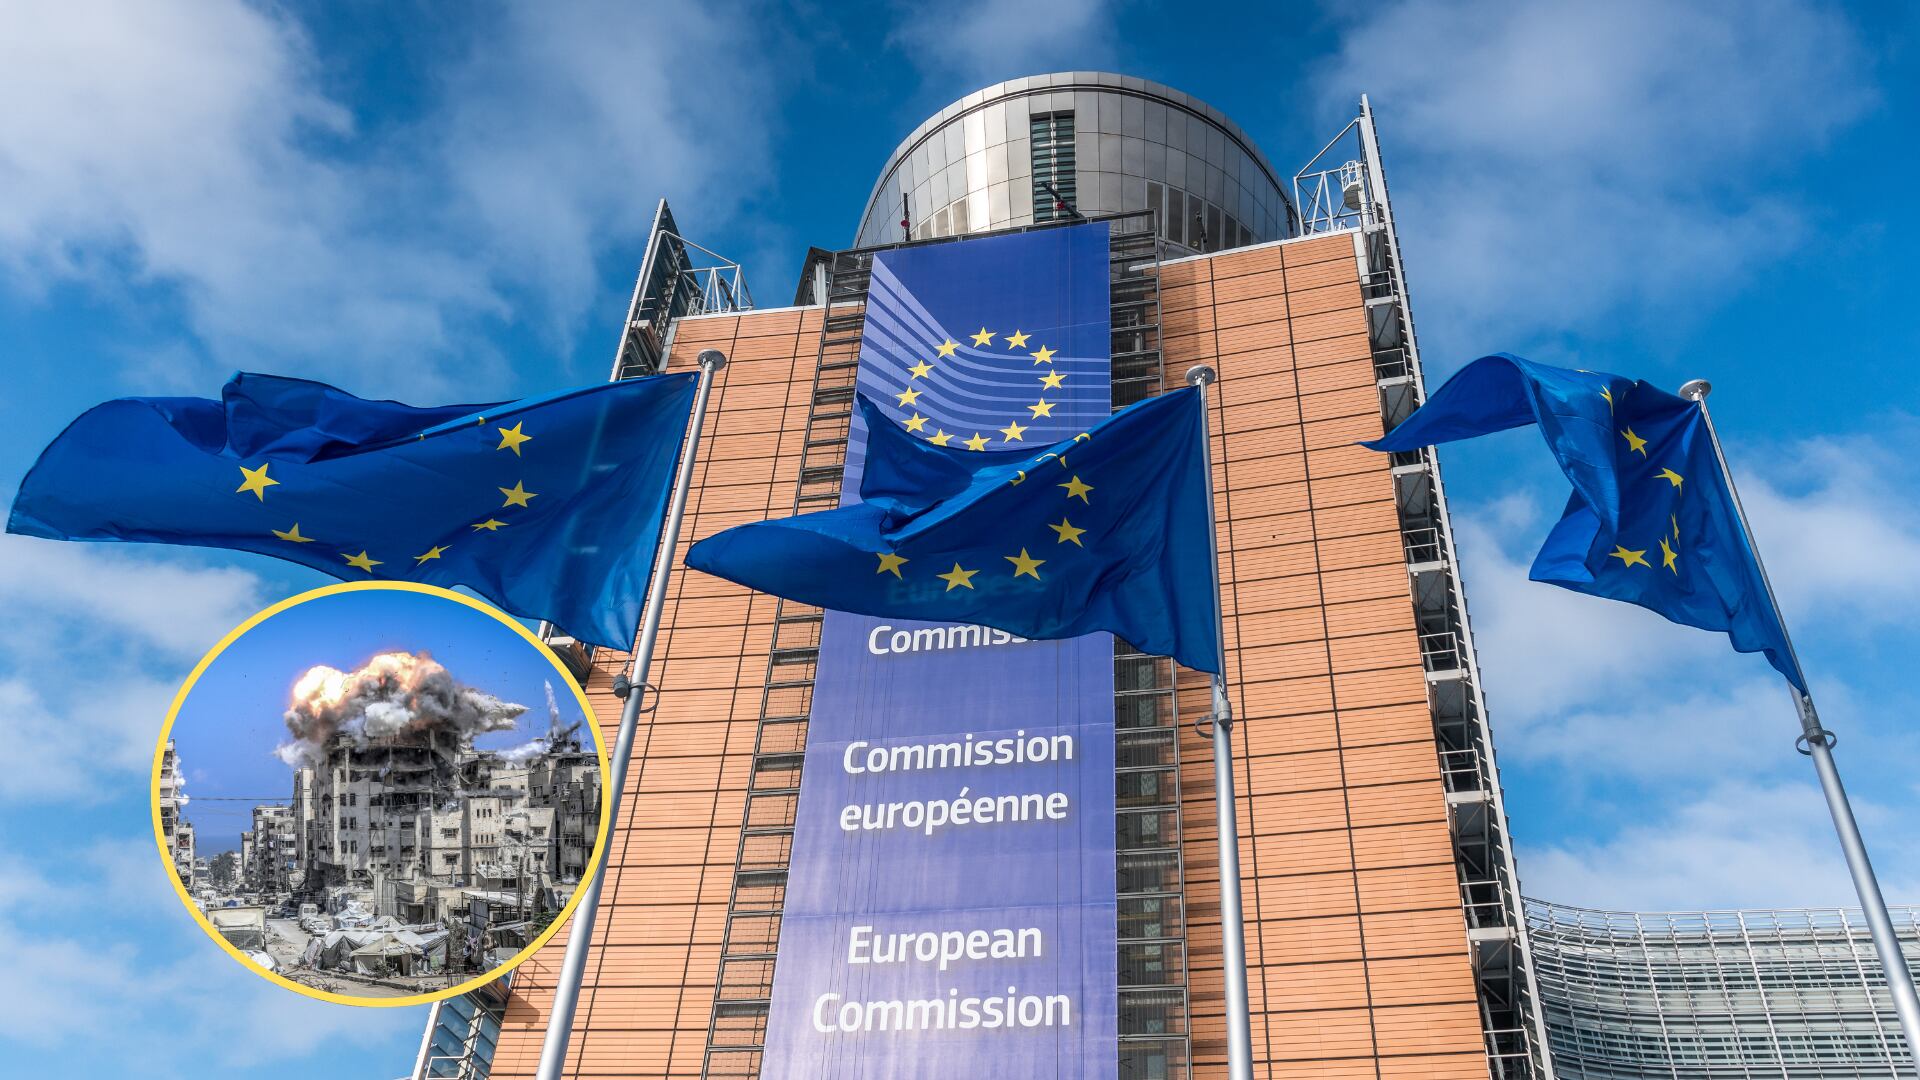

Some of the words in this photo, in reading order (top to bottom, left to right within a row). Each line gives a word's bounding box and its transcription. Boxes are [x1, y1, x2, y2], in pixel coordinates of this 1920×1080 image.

[843, 730, 1073, 774] Commission
[840, 787, 1068, 835] européenne
[847, 925, 1042, 971] European
[813, 986, 1070, 1033] Commission
